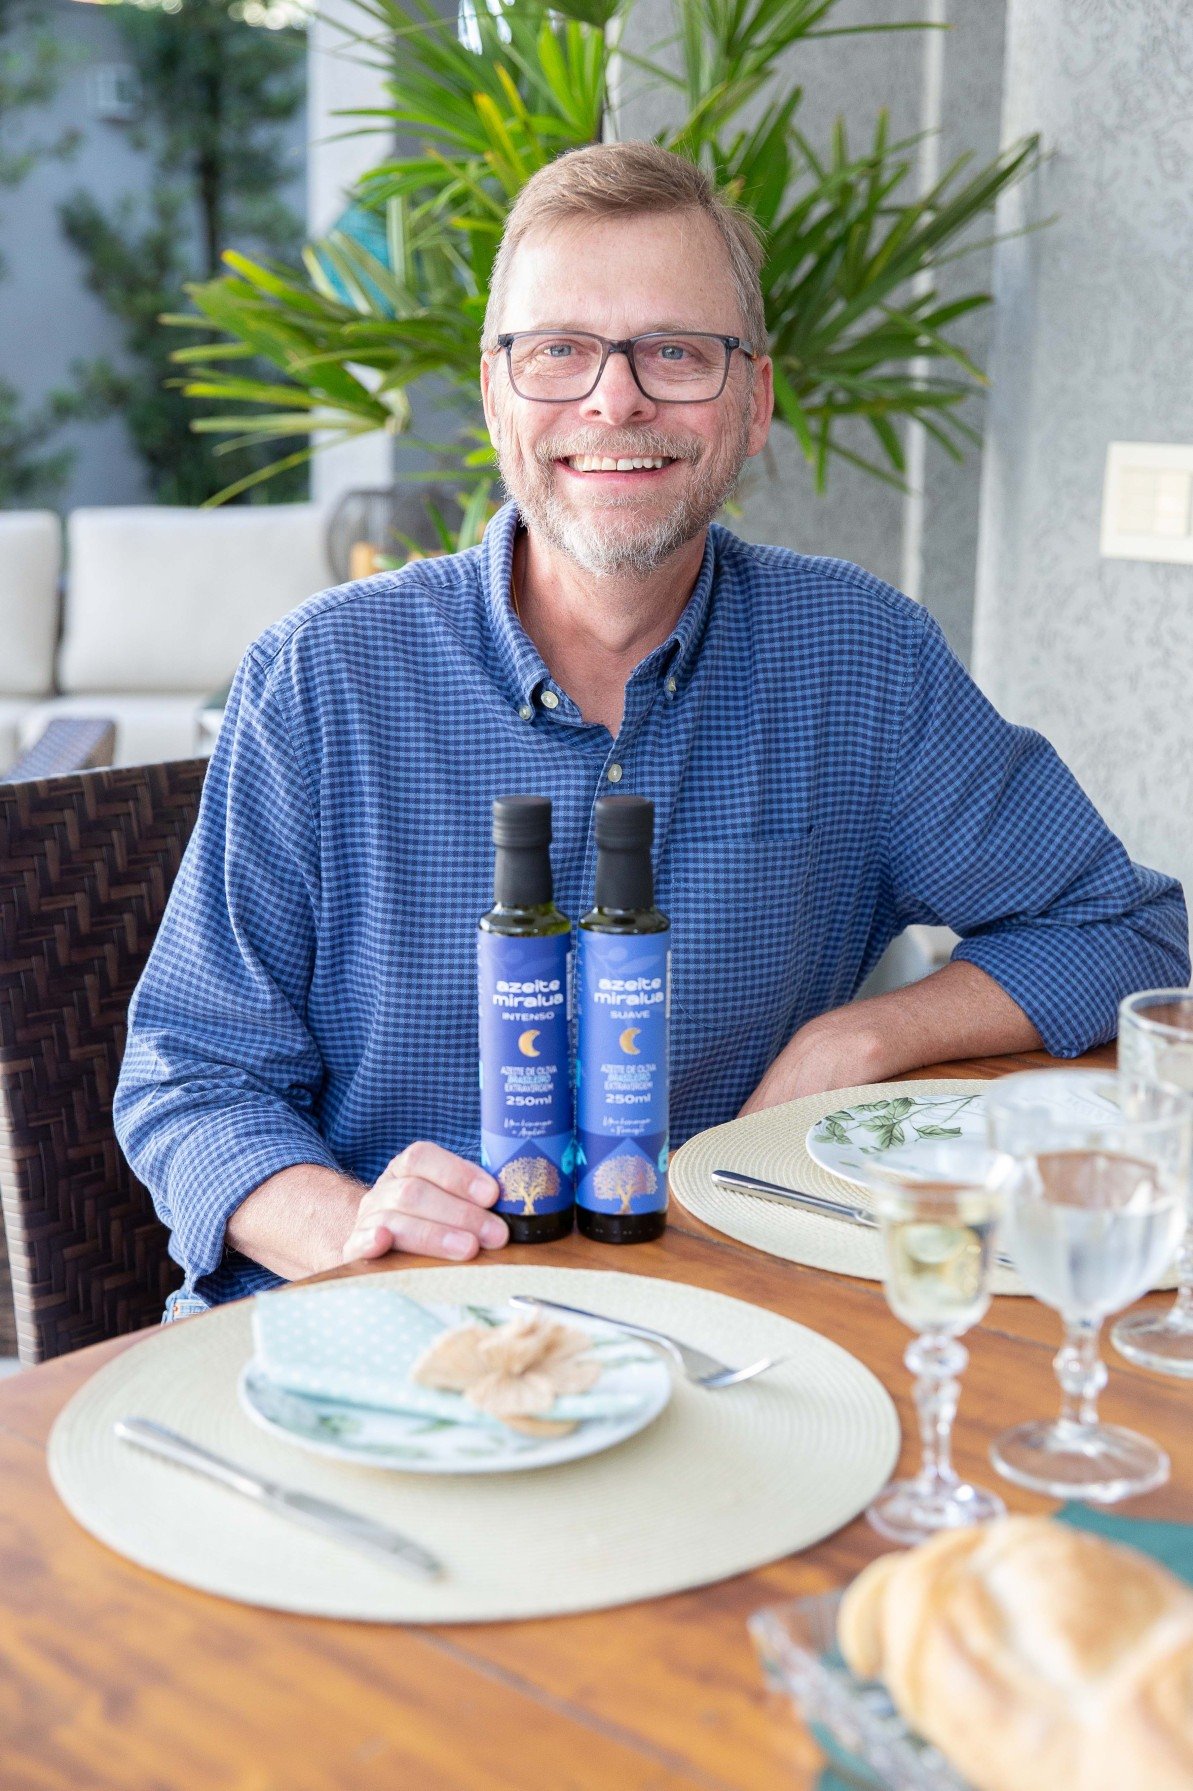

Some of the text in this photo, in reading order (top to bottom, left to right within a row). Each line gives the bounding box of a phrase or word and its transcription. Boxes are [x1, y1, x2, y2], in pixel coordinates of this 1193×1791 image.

[496, 979, 560, 994] azeite
[598, 977, 661, 991] azeite
[492, 993, 564, 1008] miralua
[594, 991, 664, 1006] miralua
[502, 1011, 555, 1021] INTENSO
[610, 1009, 650, 1019] SUAVE
[505, 1095, 552, 1106] 250ml
[605, 1093, 651, 1104] 250ml
